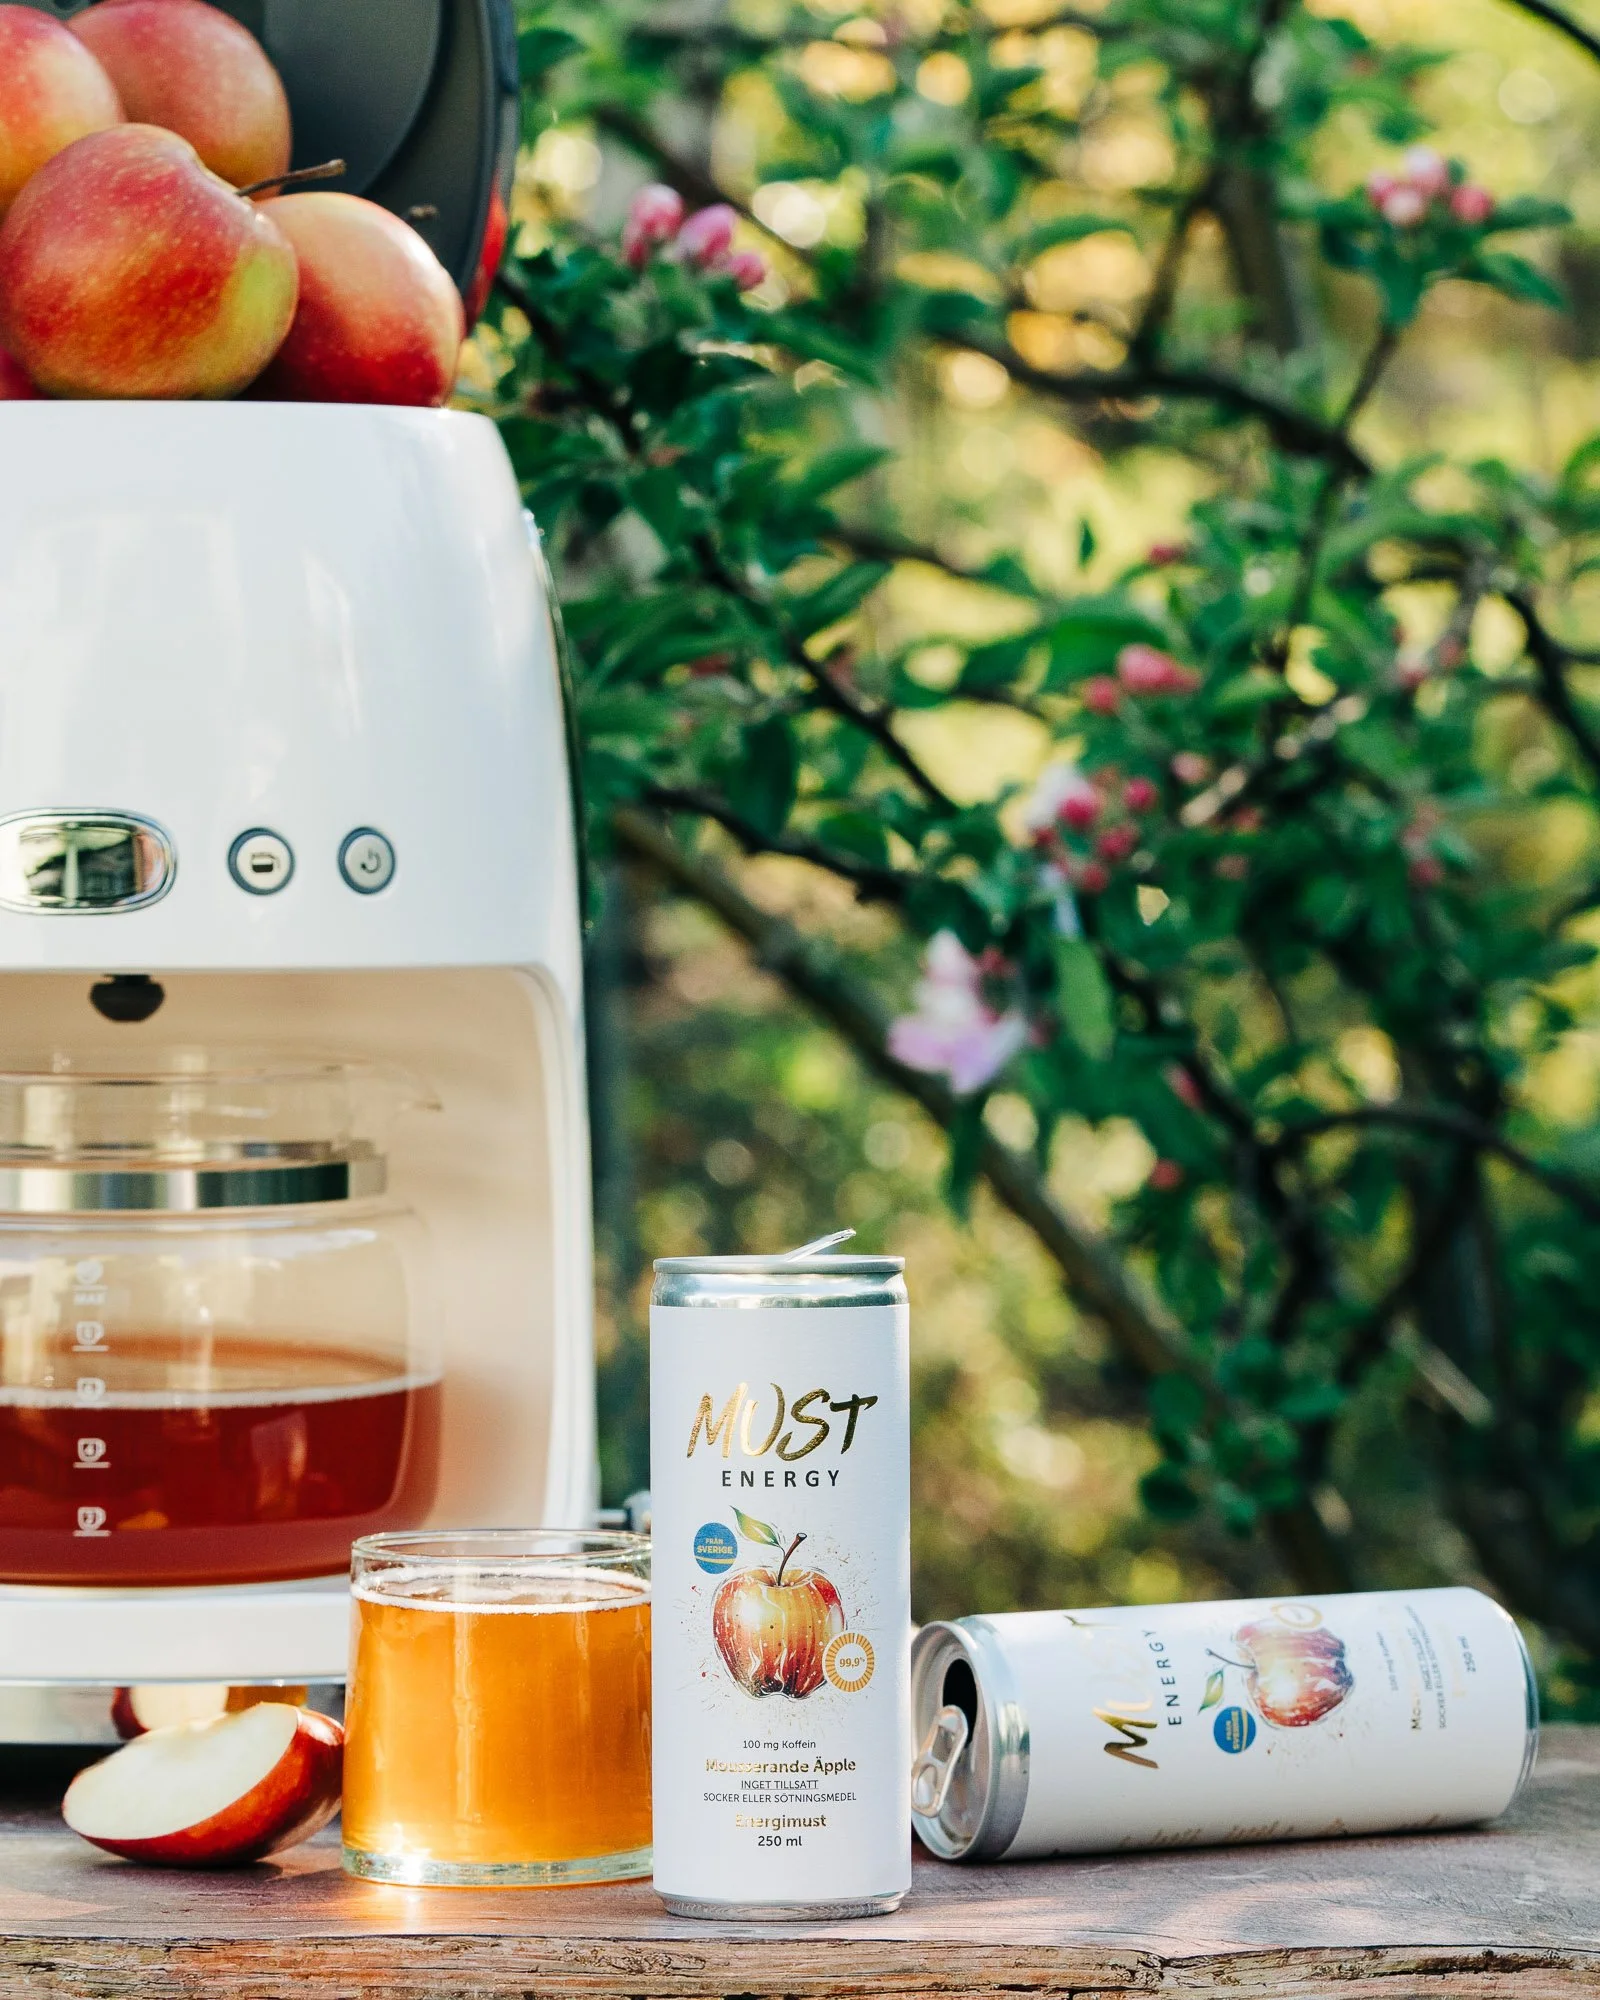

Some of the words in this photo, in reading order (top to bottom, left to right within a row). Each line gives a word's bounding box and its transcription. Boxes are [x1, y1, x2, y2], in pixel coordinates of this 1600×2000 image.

[686, 1381, 879, 1462] MUST
[721, 1469, 840, 1488] ENERGY
[697, 1545, 733, 1554] SVERIGE
[1141, 1629, 1183, 1726] ENERGY
[743, 1740, 760, 1749] 100
[763, 1741, 779, 1751] mg
[782, 1739, 816, 1749] Koffein
[705, 1759, 809, 1773] Mousserande
[813, 1756, 856, 1776] Äpple
[741, 1780, 772, 1789] INGET
[774, 1780, 819, 1789] TILLSATT
[703, 1793, 740, 1803] SOCKER
[742, 1794, 772, 1803] ELLER
[774, 1792, 857, 1803] SÖTNINGSMEDEL
[736, 1814, 827, 1831] Energimust
[758, 1836, 782, 1847] 250
[786, 1835, 803, 1847] ml
